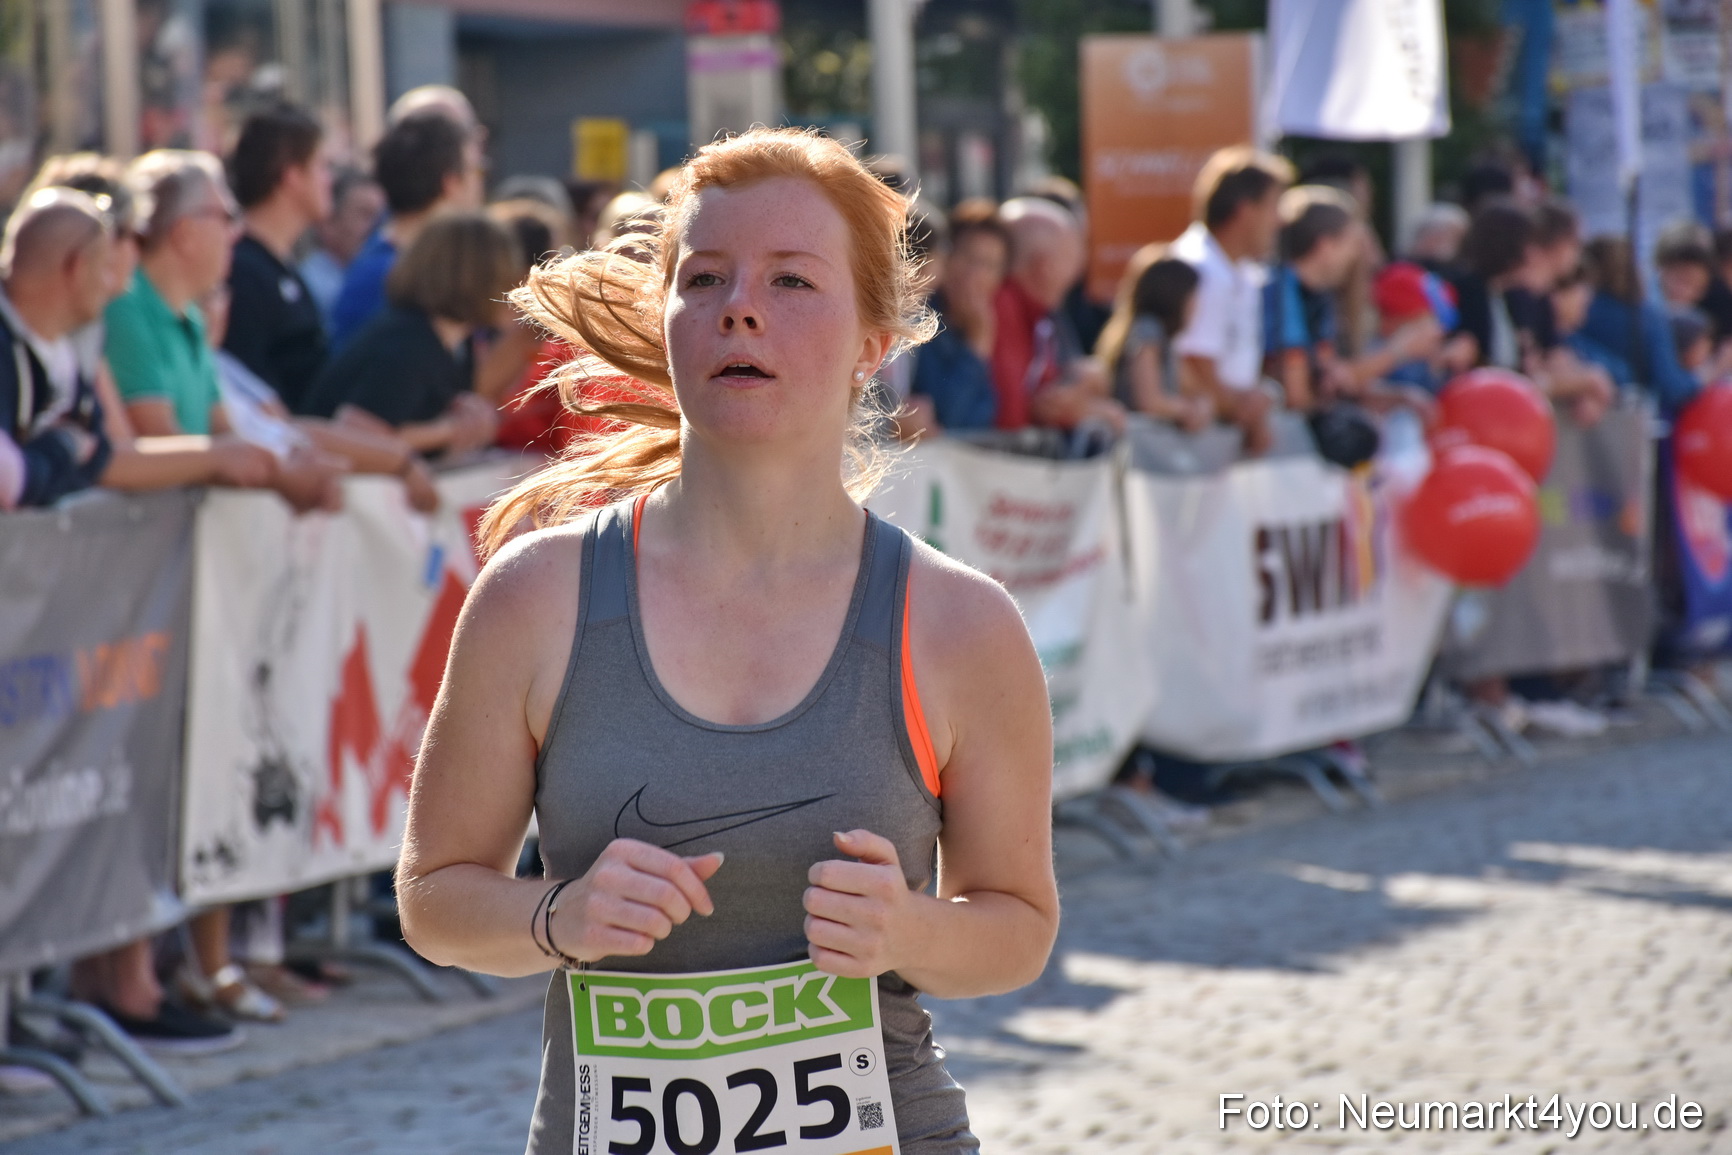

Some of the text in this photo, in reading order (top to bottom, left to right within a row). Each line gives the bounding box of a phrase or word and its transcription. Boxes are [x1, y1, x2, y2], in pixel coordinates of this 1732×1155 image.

[592, 974, 846, 1046] BOCK
[856, 1054, 869, 1069] S
[608, 1053, 851, 1155] 5025
